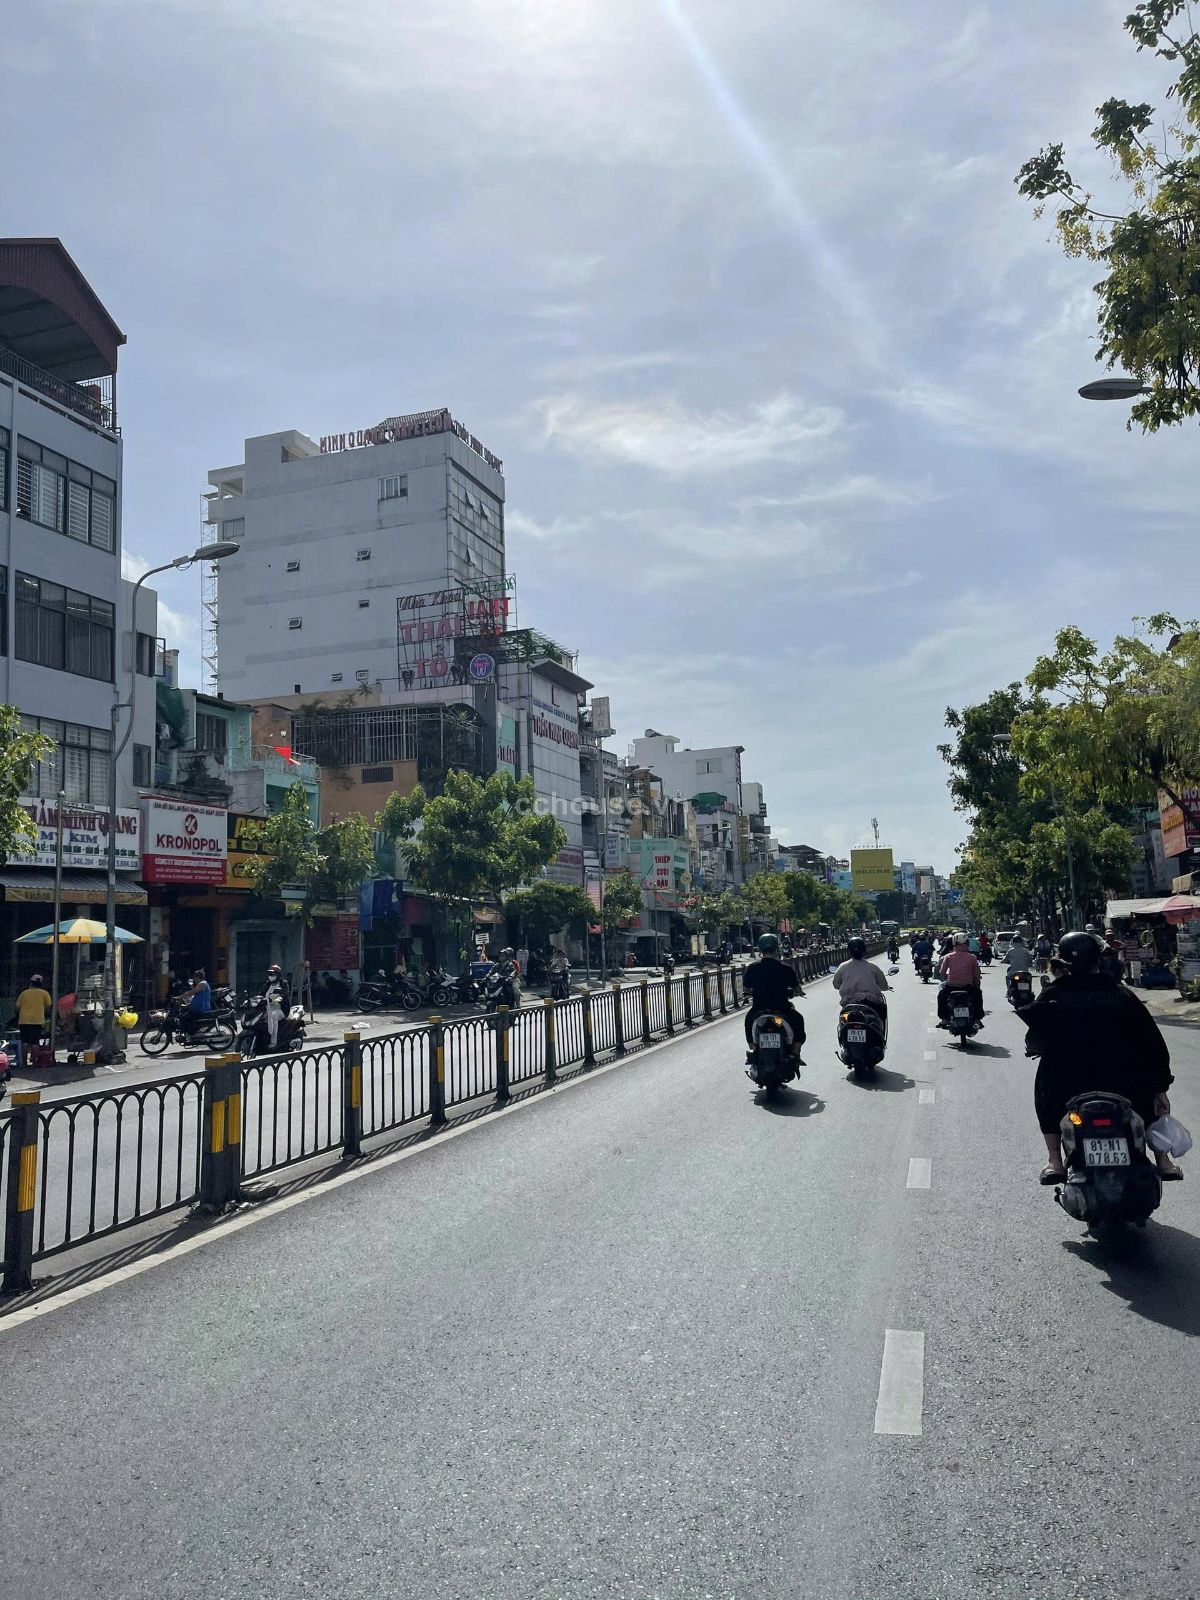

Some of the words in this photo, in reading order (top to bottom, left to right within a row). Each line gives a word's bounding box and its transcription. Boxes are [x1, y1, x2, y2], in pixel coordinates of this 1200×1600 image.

[320, 433, 346, 454] MINH
[69, 831, 98, 844] KIM
[157, 834, 222, 853] KRONOPOL
[1088, 1151, 1128, 1165] 078.63
